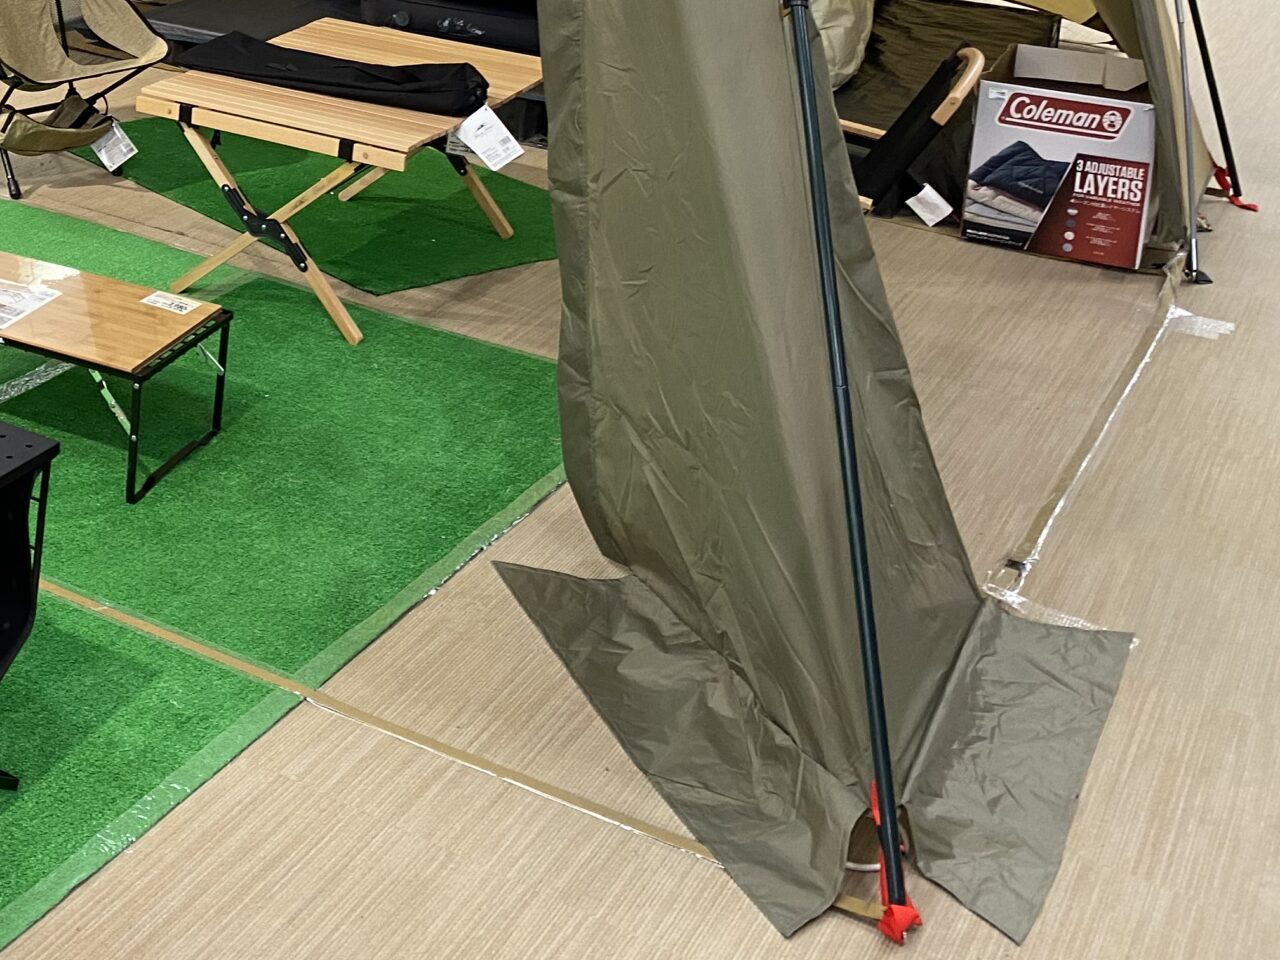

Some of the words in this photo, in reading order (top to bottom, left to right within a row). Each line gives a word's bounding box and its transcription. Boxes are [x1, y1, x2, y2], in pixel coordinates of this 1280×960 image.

[1009, 96, 1101, 130] Coleman
[1076, 159, 1084, 172] 3
[1084, 161, 1145, 181] ADJUSTABLE
[1073, 171, 1144, 203] LAYERS
